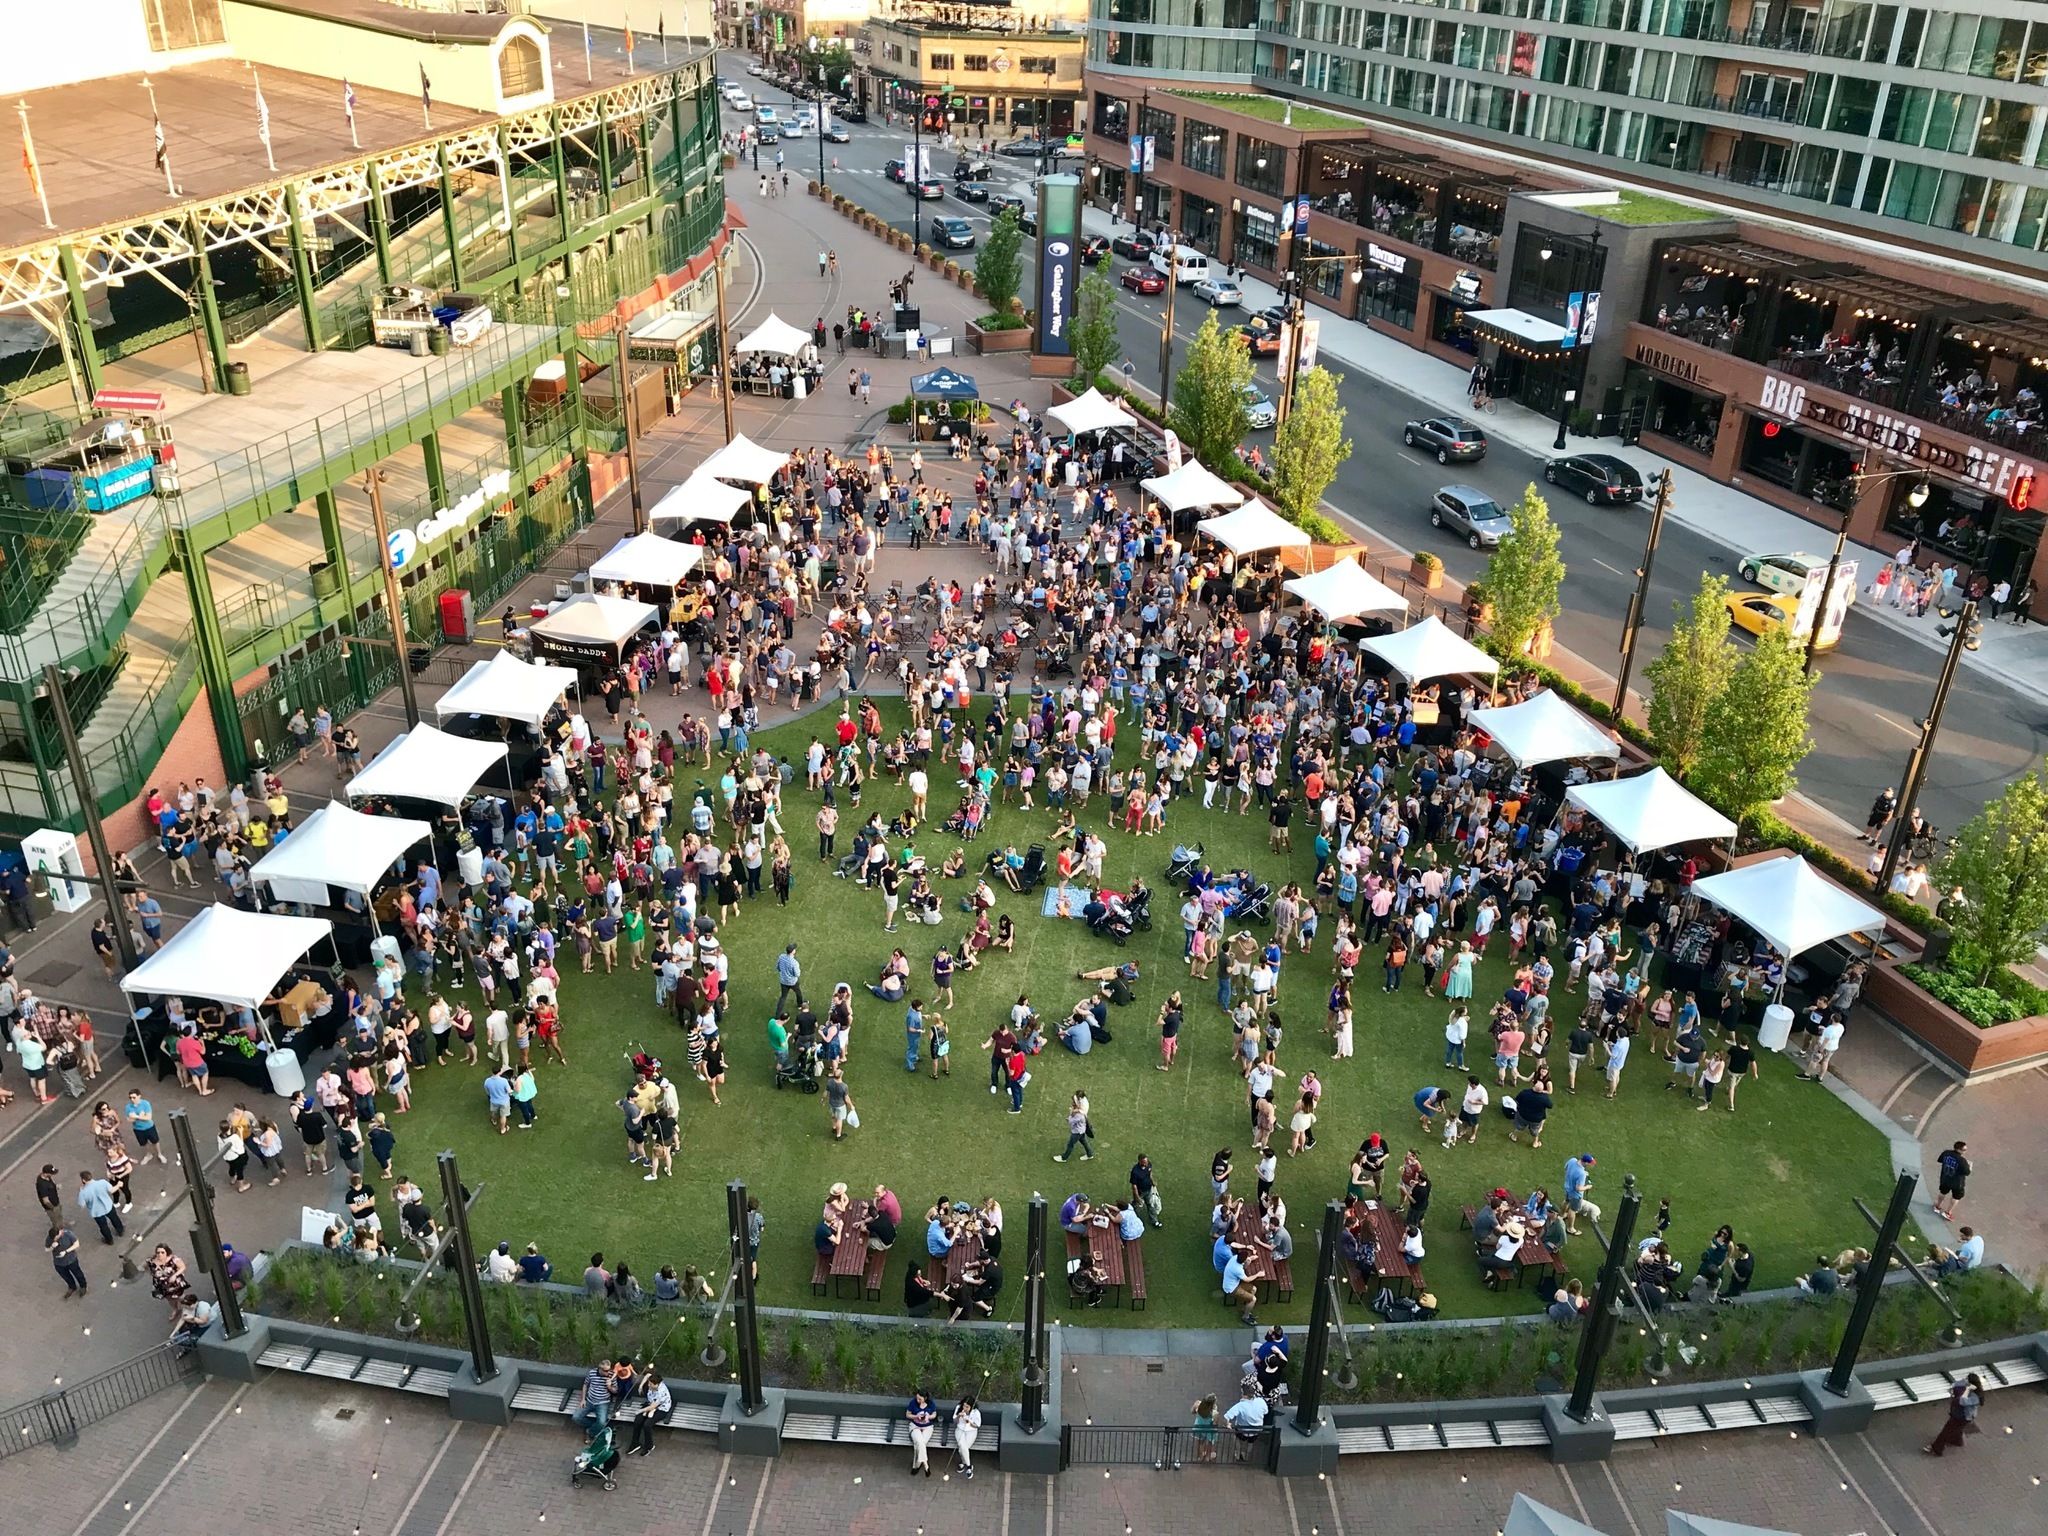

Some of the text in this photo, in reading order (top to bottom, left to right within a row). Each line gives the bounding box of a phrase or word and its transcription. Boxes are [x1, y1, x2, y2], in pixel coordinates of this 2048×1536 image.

[1050, 264, 1064, 337] Gallagher Way
[1635, 343, 1699, 382] MORDECAI
[1760, 375, 1806, 420] BBQ
[543, 642, 607, 657] SMOKE DADDY
[58, 839, 71, 852] ATM
